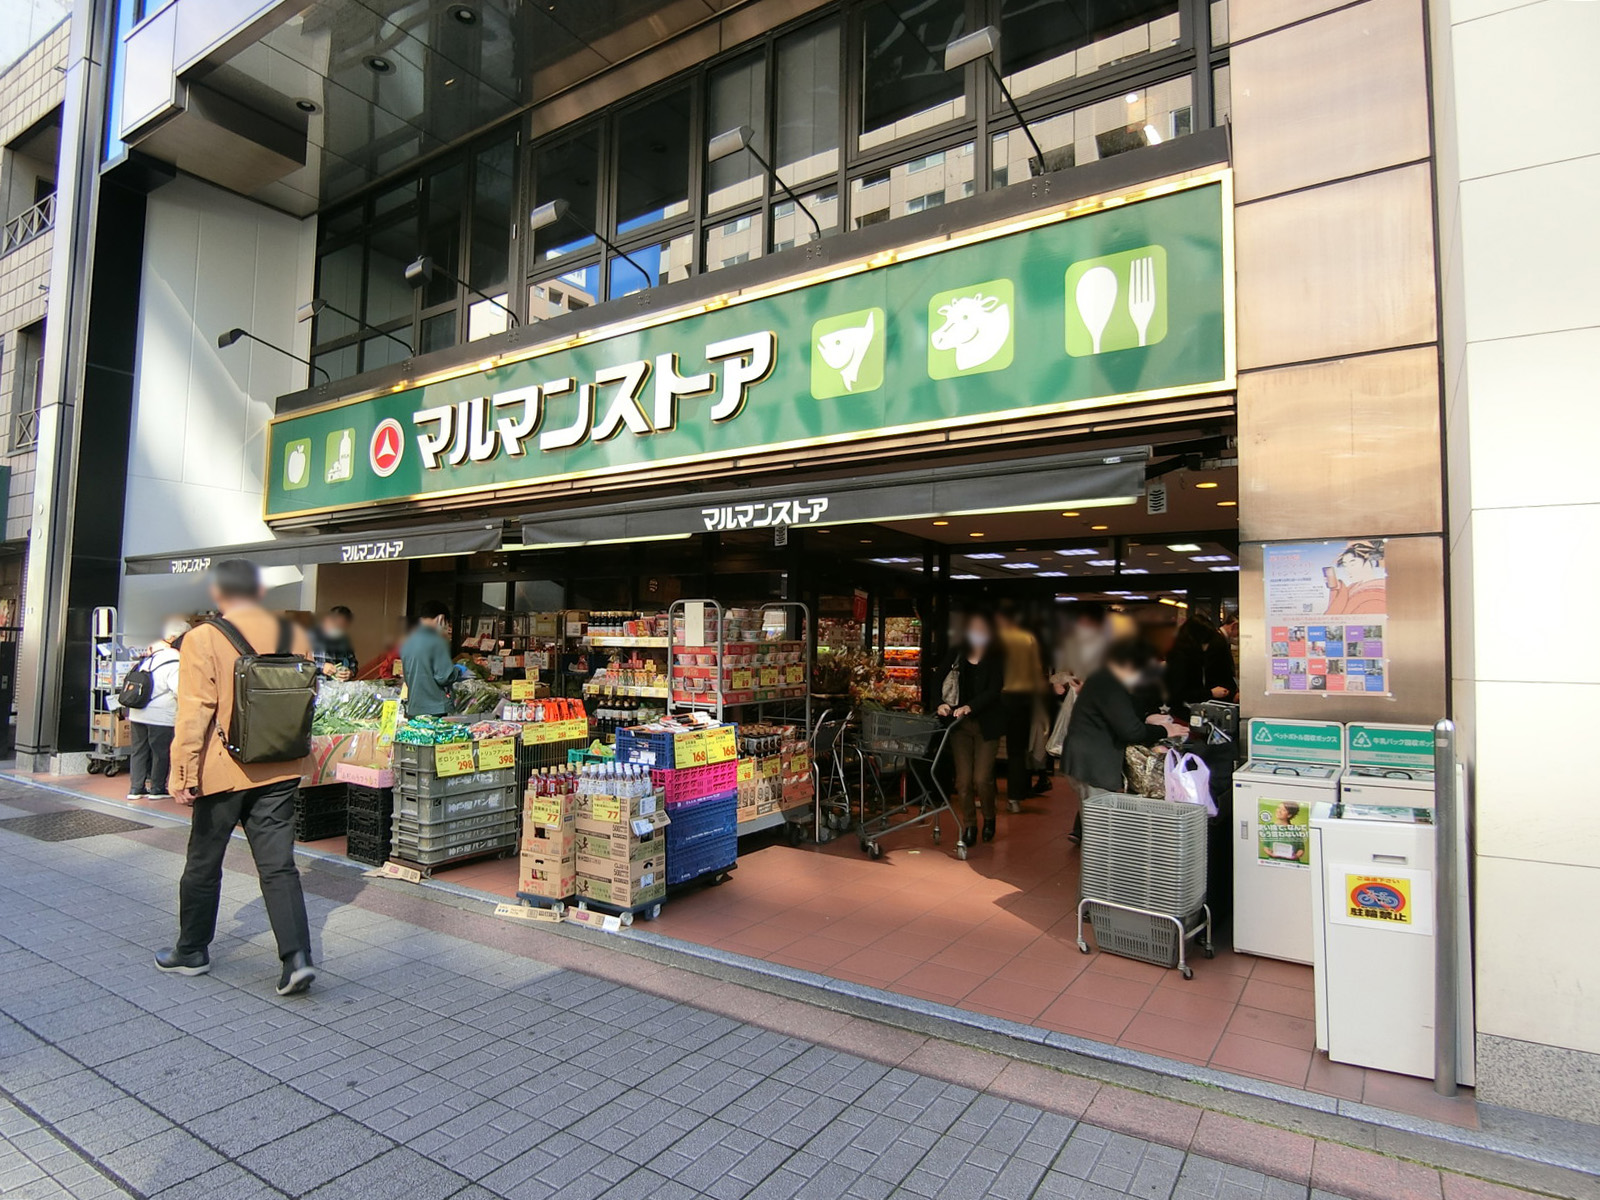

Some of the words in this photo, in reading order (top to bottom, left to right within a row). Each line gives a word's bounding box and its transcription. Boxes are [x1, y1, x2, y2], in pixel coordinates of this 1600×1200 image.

[412, 330, 777, 471] マルマンストア
[701, 496, 829, 532] マルマンストア
[341, 540, 404, 563] マルマンストア
[170, 557, 211, 574] マルマンストア
[1273, 732, 1338, 743] ペットボトル回収ボックス
[692, 750, 706, 763] 168
[722, 746, 736, 757] 168
[457, 760, 473, 771] 298
[498, 754, 514, 765] 398
[546, 813, 559, 822] 77
[606, 810, 619, 819] 77
[448, 841, 487, 856] 神戸屋パン
[1356, 876, 1401, 884] ご遠慮下さい
[1350, 907, 1407, 922] 駐輪禁止
